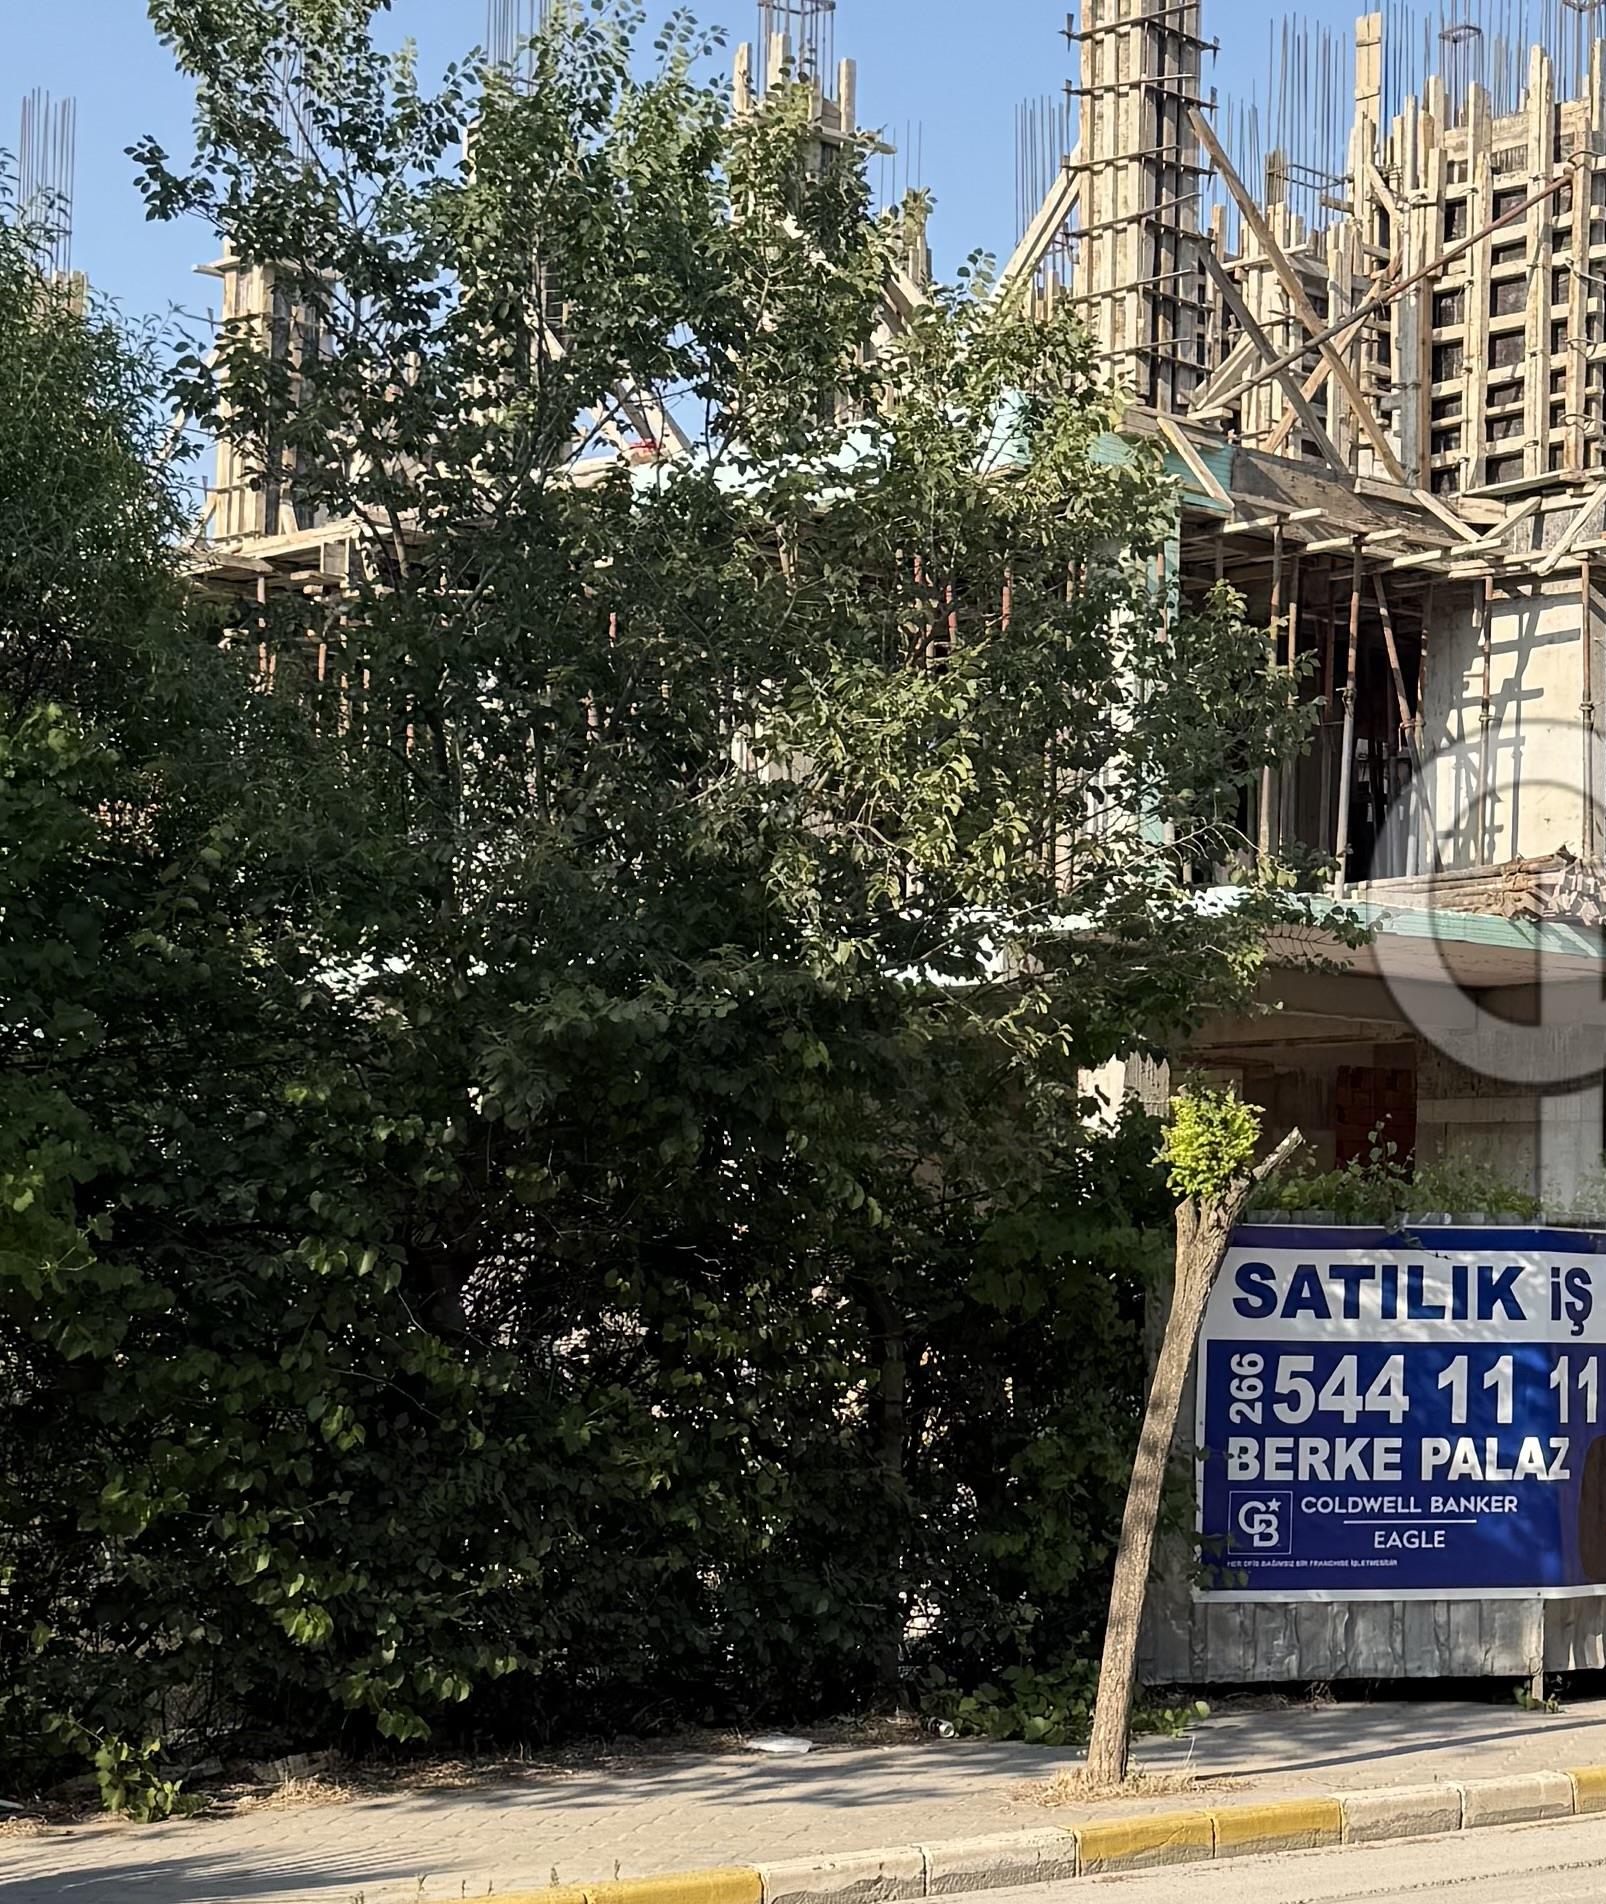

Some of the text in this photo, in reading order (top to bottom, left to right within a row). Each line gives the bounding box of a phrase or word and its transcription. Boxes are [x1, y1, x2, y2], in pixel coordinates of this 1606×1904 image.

[1231, 1261, 1527, 1321] SATILIK
[1229, 1352, 1264, 1425] 266
[1272, 1354, 1598, 1424] 544 11 11
[1226, 1436, 1571, 1481] BERKE PALAZ
[1300, 1495, 1518, 1514] COLDWELL BANKER
[1374, 1530, 1446, 1549] EAGLE
